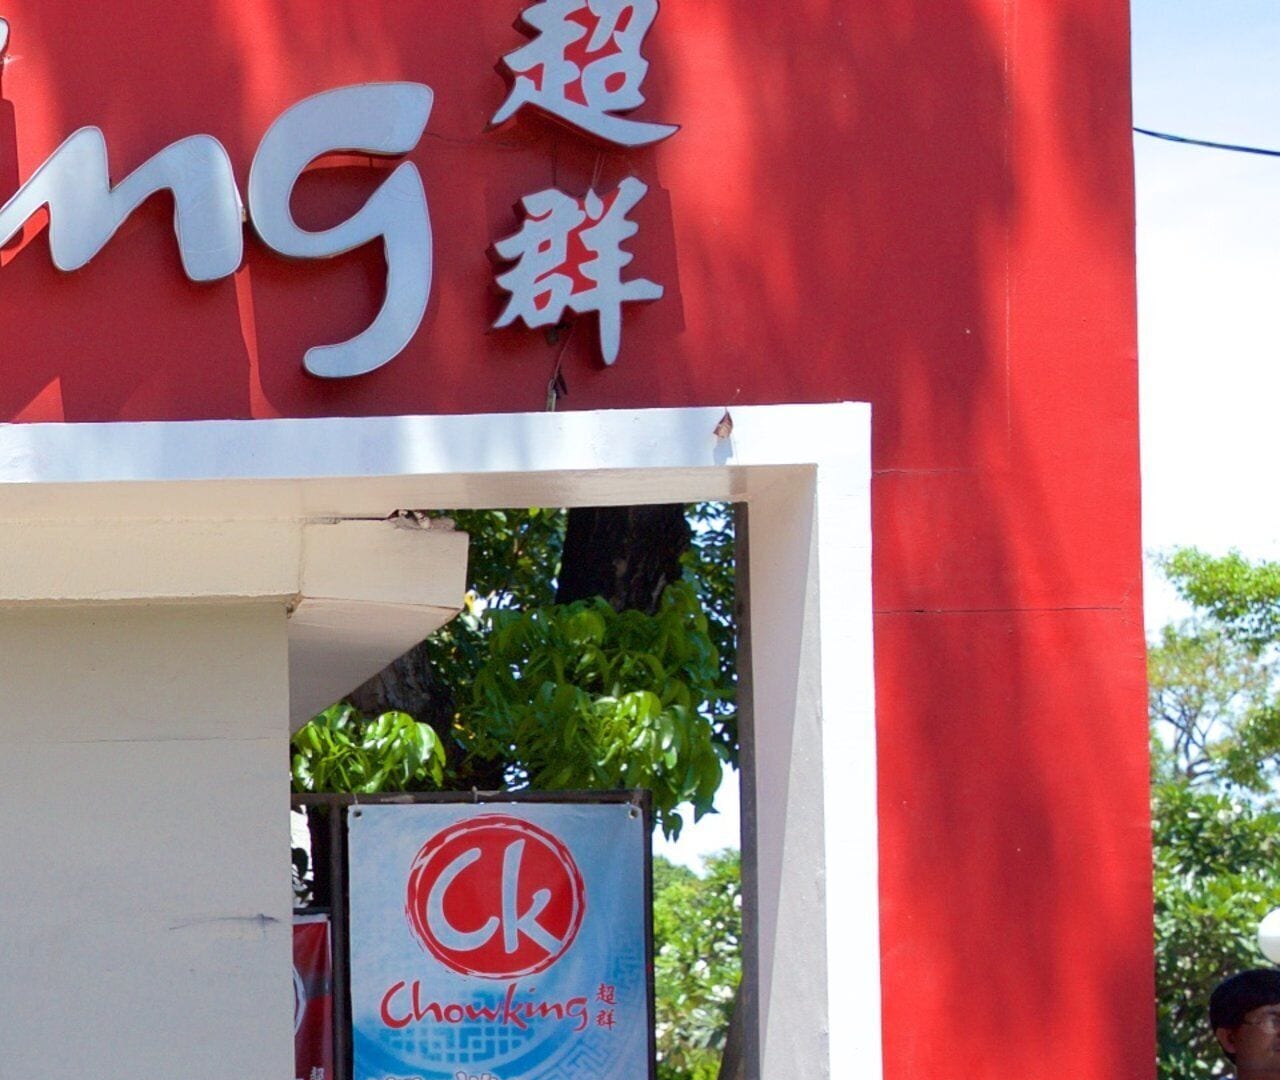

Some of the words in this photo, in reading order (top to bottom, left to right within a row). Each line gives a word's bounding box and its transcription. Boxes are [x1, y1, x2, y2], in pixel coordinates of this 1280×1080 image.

[490, 0, 682, 366] 超群
[426, 838, 562, 954] Ck
[381, 980, 588, 1031] Chowking
[596, 983, 617, 1030] 超群
